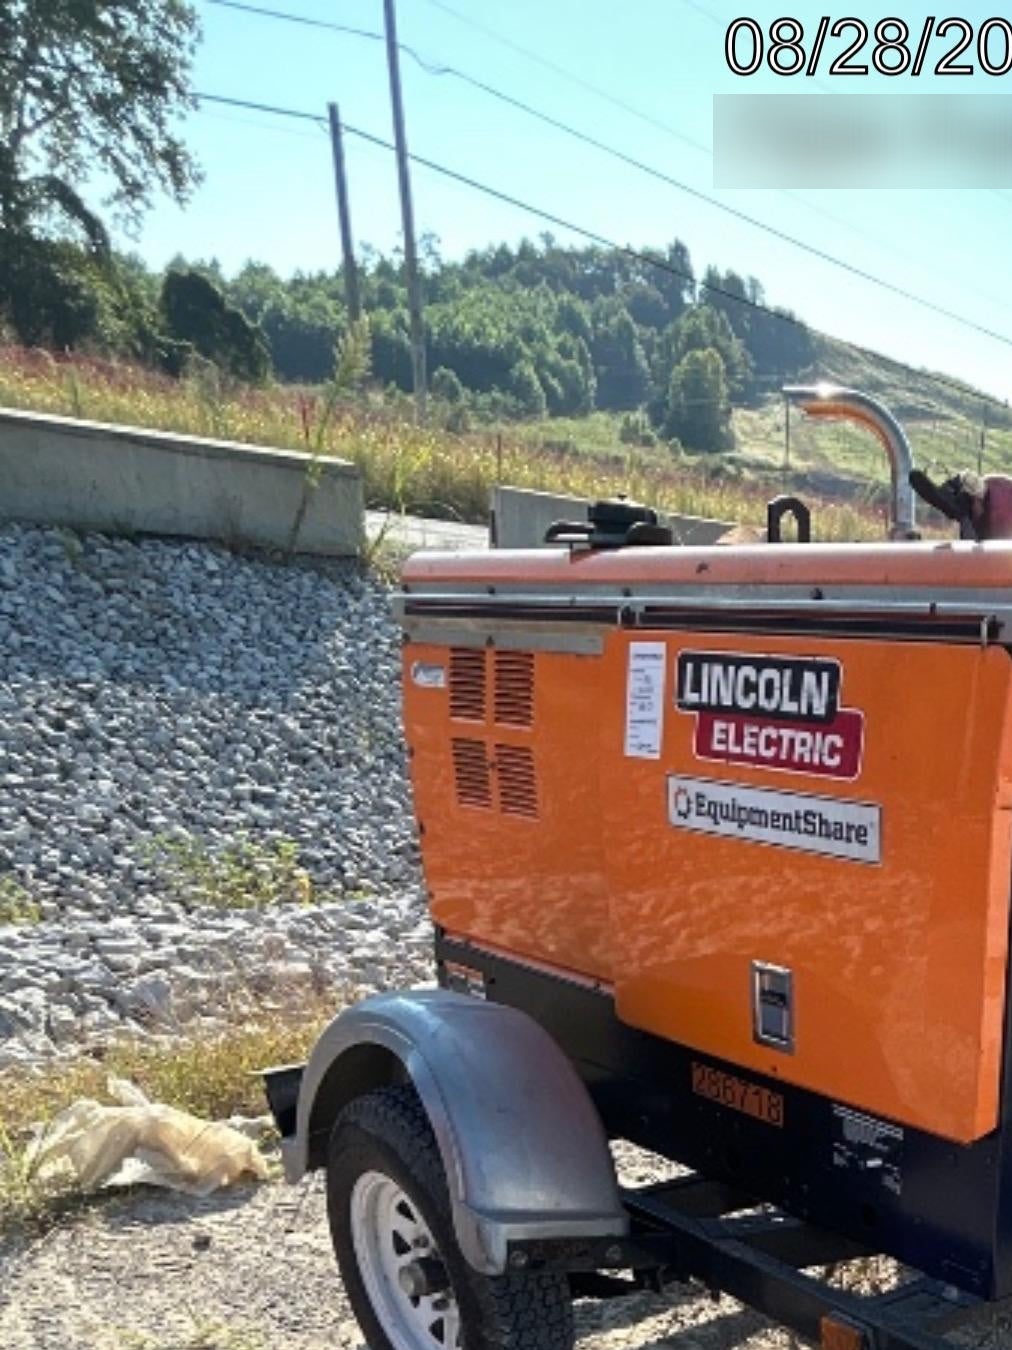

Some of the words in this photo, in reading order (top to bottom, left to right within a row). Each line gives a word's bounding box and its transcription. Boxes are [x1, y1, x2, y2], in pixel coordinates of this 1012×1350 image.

[683, 662, 830, 716] LINCOLN
[711, 720, 844, 767] ELECTRIC
[695, 792, 868, 845] EquipmentShare
[694, 1065, 781, 1124] 286718
